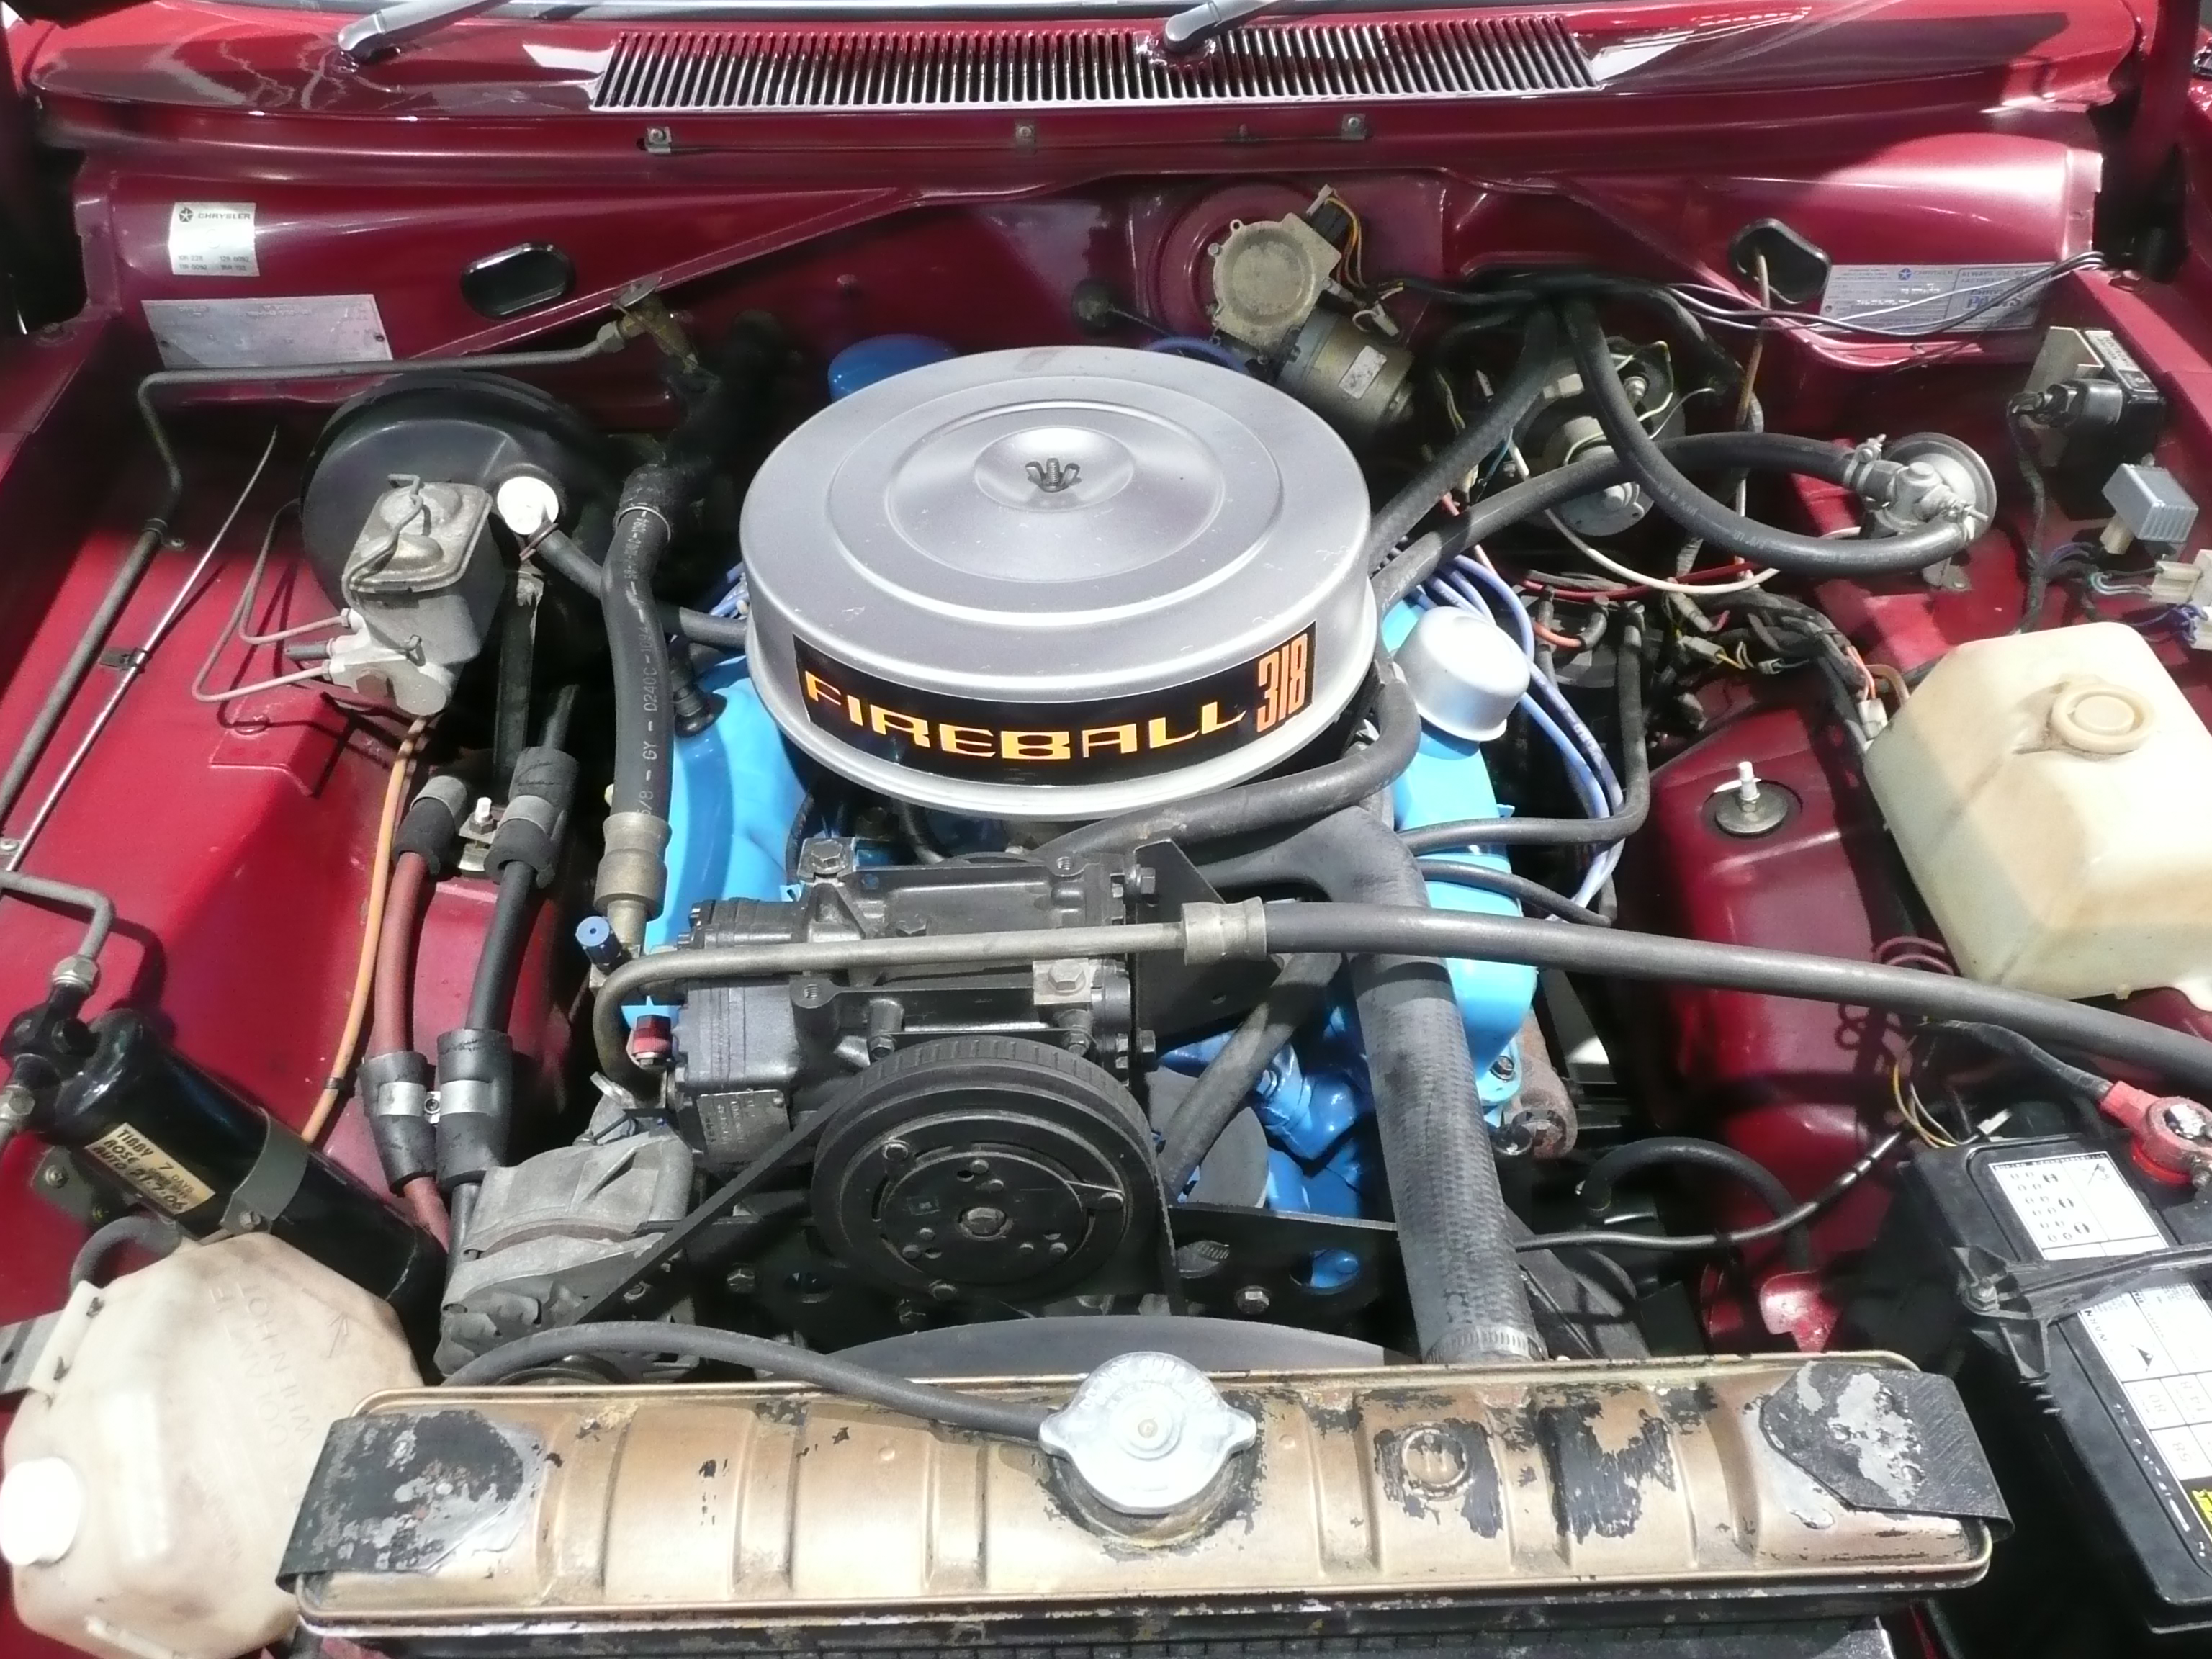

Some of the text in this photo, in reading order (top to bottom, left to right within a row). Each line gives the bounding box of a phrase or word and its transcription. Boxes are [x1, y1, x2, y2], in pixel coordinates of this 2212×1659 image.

[804, 632, 1308, 760] FIREBALL 318
[643, 740, 658, 760] GY
[93, 1146, 127, 1170] AUTO
[104, 1139, 140, 1164] ROSE
[235, 1281, 280, 1342] HOT
[1097, 1359, 1130, 1384] NOT
[269, 1349, 315, 1442] WHEN
